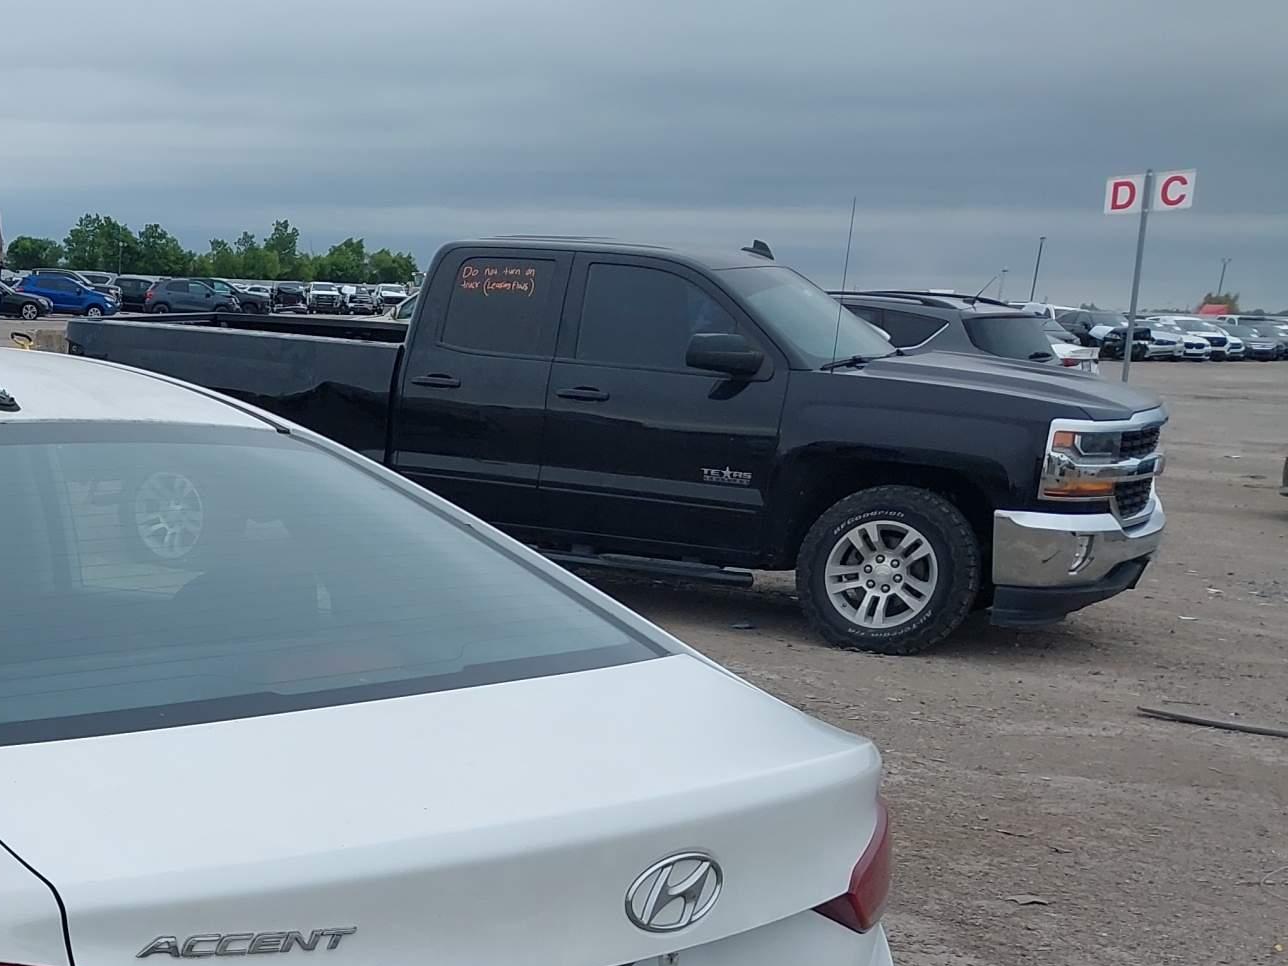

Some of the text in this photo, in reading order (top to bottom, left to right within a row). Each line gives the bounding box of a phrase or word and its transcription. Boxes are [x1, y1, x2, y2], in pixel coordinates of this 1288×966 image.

[1111, 181, 1136, 210] D
[1161, 175, 1188, 206] C
[463, 266, 479, 278] Do
[503, 267, 521, 275] turn
[700, 466, 753, 480] TEXAS
[136, 926, 358, 958] ACCENT
